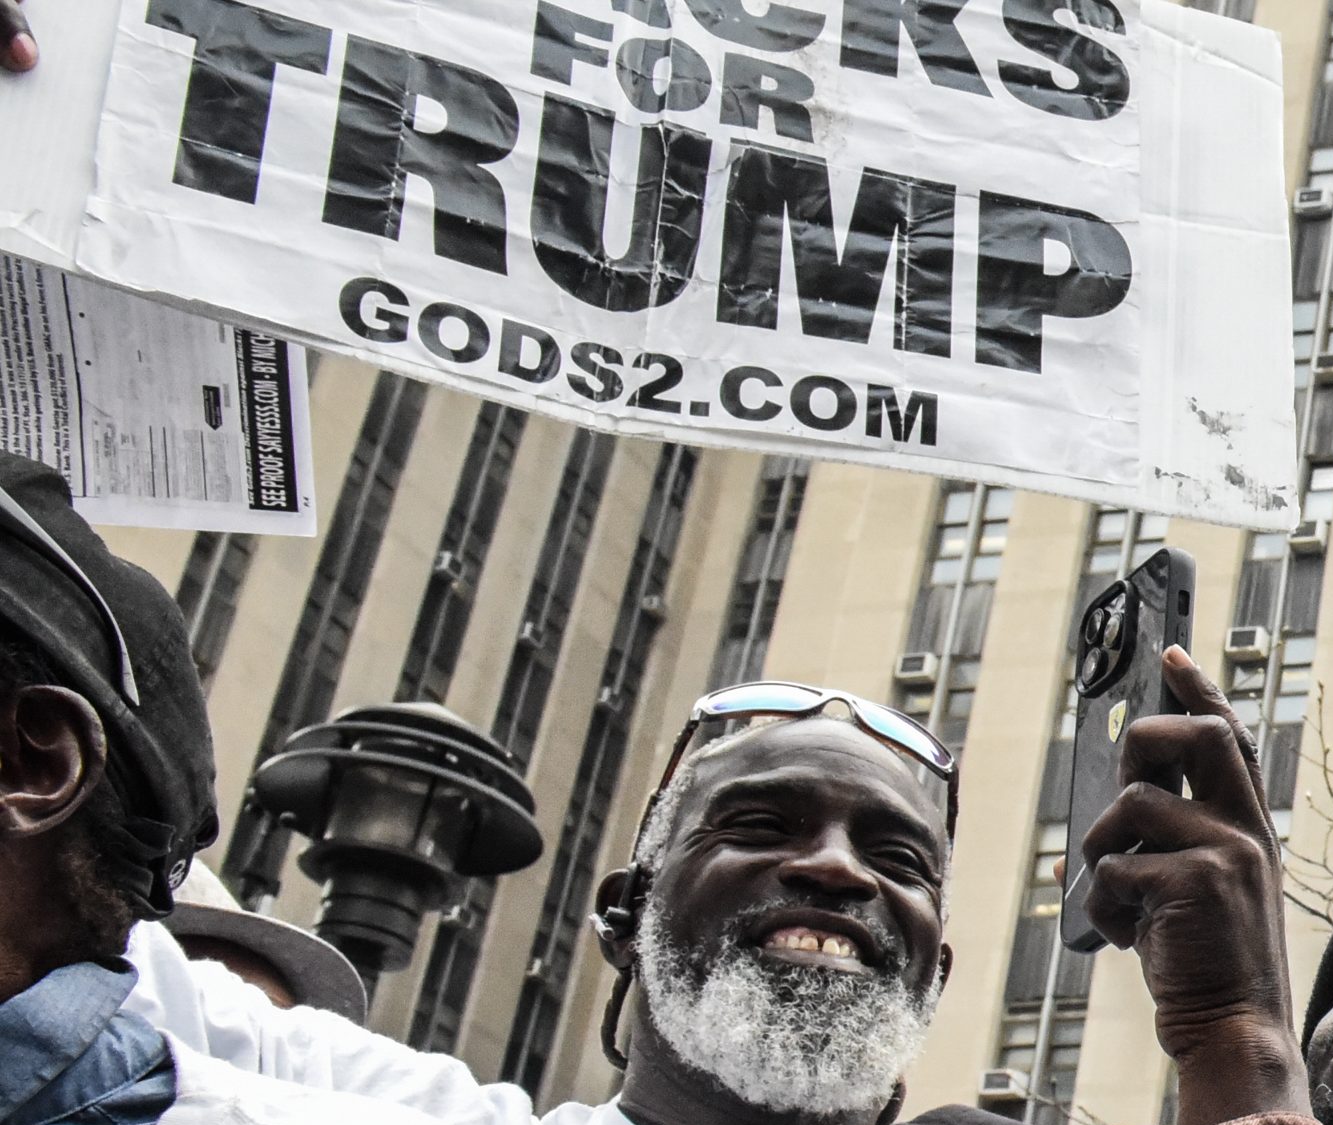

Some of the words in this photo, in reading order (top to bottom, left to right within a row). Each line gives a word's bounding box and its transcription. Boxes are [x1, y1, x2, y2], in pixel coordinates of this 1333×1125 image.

[530, 0, 815, 143] FOR
[145, 0, 1132, 374] TRUMP
[250, 332, 277, 359] MICH
[252, 359, 278, 373] BY
[338, 277, 939, 446] GODS2.COM
[253, 380, 283, 453] SAYYESSS.COM
[259, 453, 285, 488] PROOF
[262, 489, 287, 507] SEE
